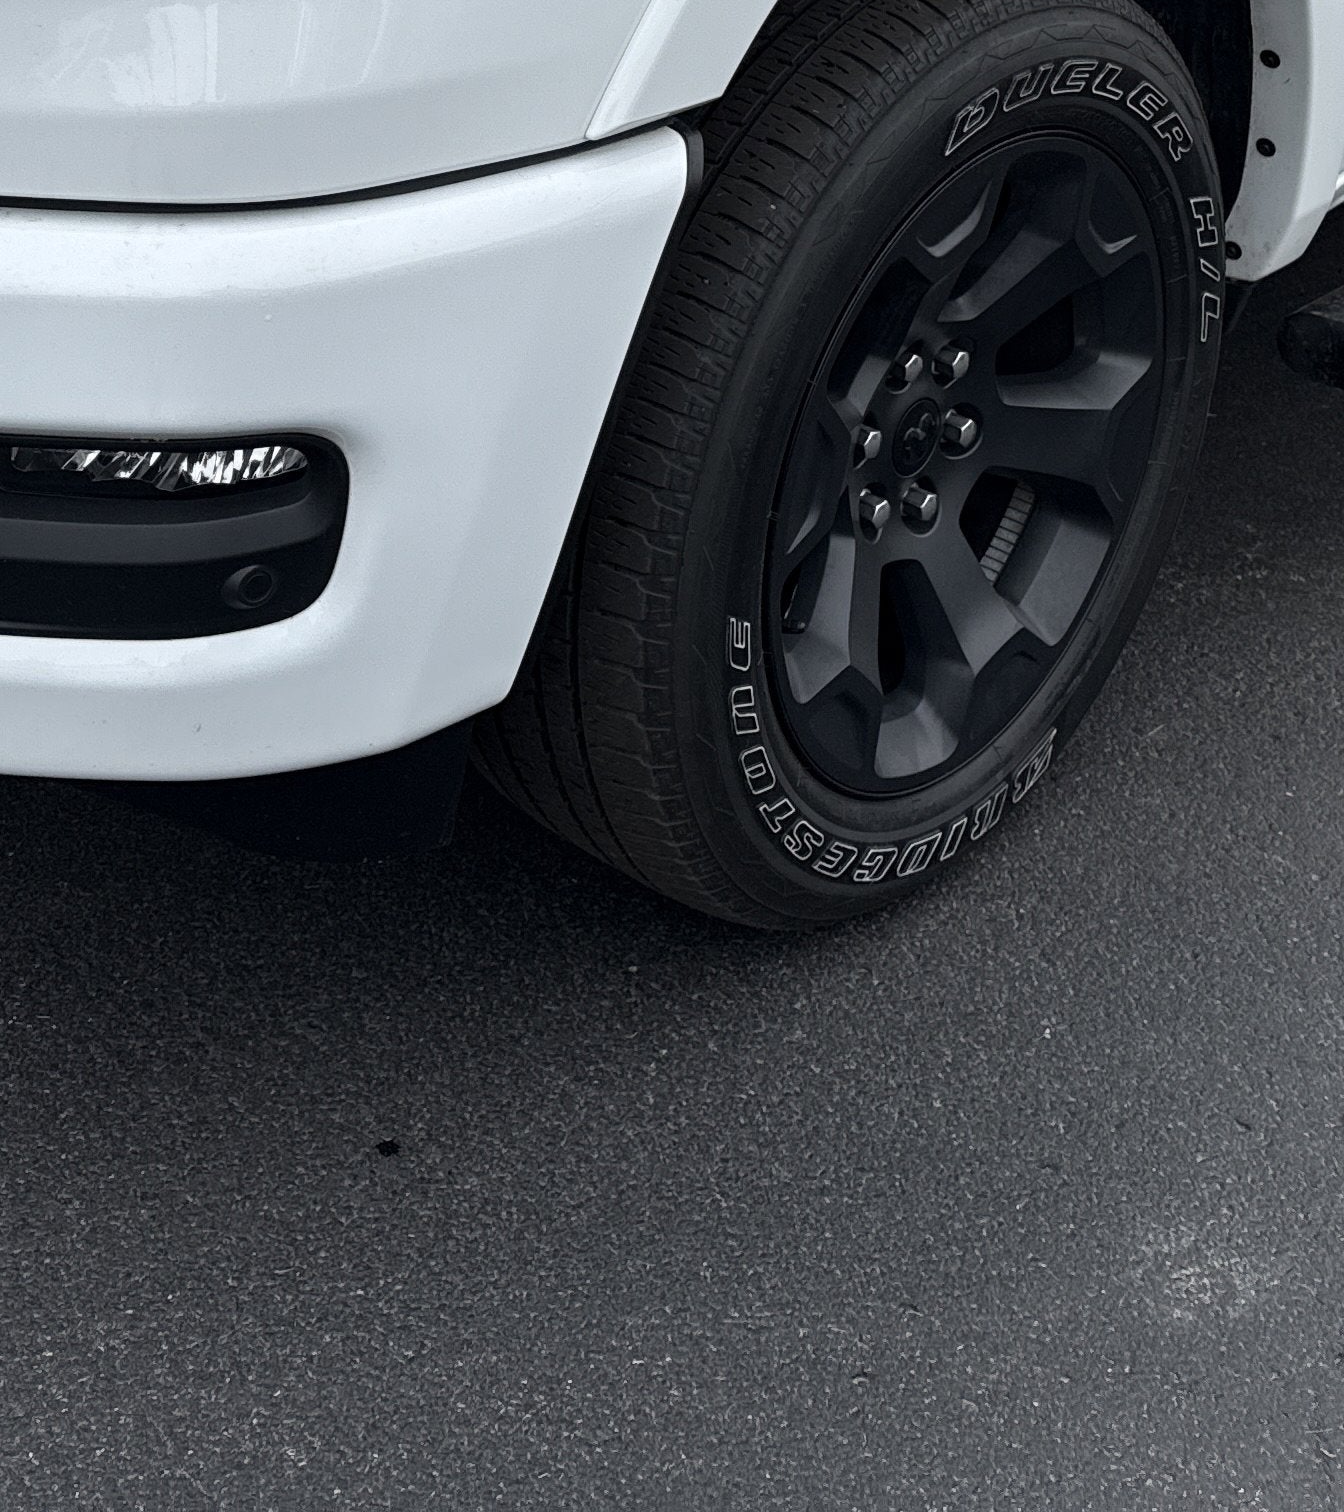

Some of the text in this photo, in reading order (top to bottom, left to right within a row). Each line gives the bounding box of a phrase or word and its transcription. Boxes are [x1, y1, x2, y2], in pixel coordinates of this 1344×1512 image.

[944, 58, 1195, 162] DUELER
[1189, 195, 1221, 344] H/L
[726, 616, 1058, 883] BRIDGESTONE
